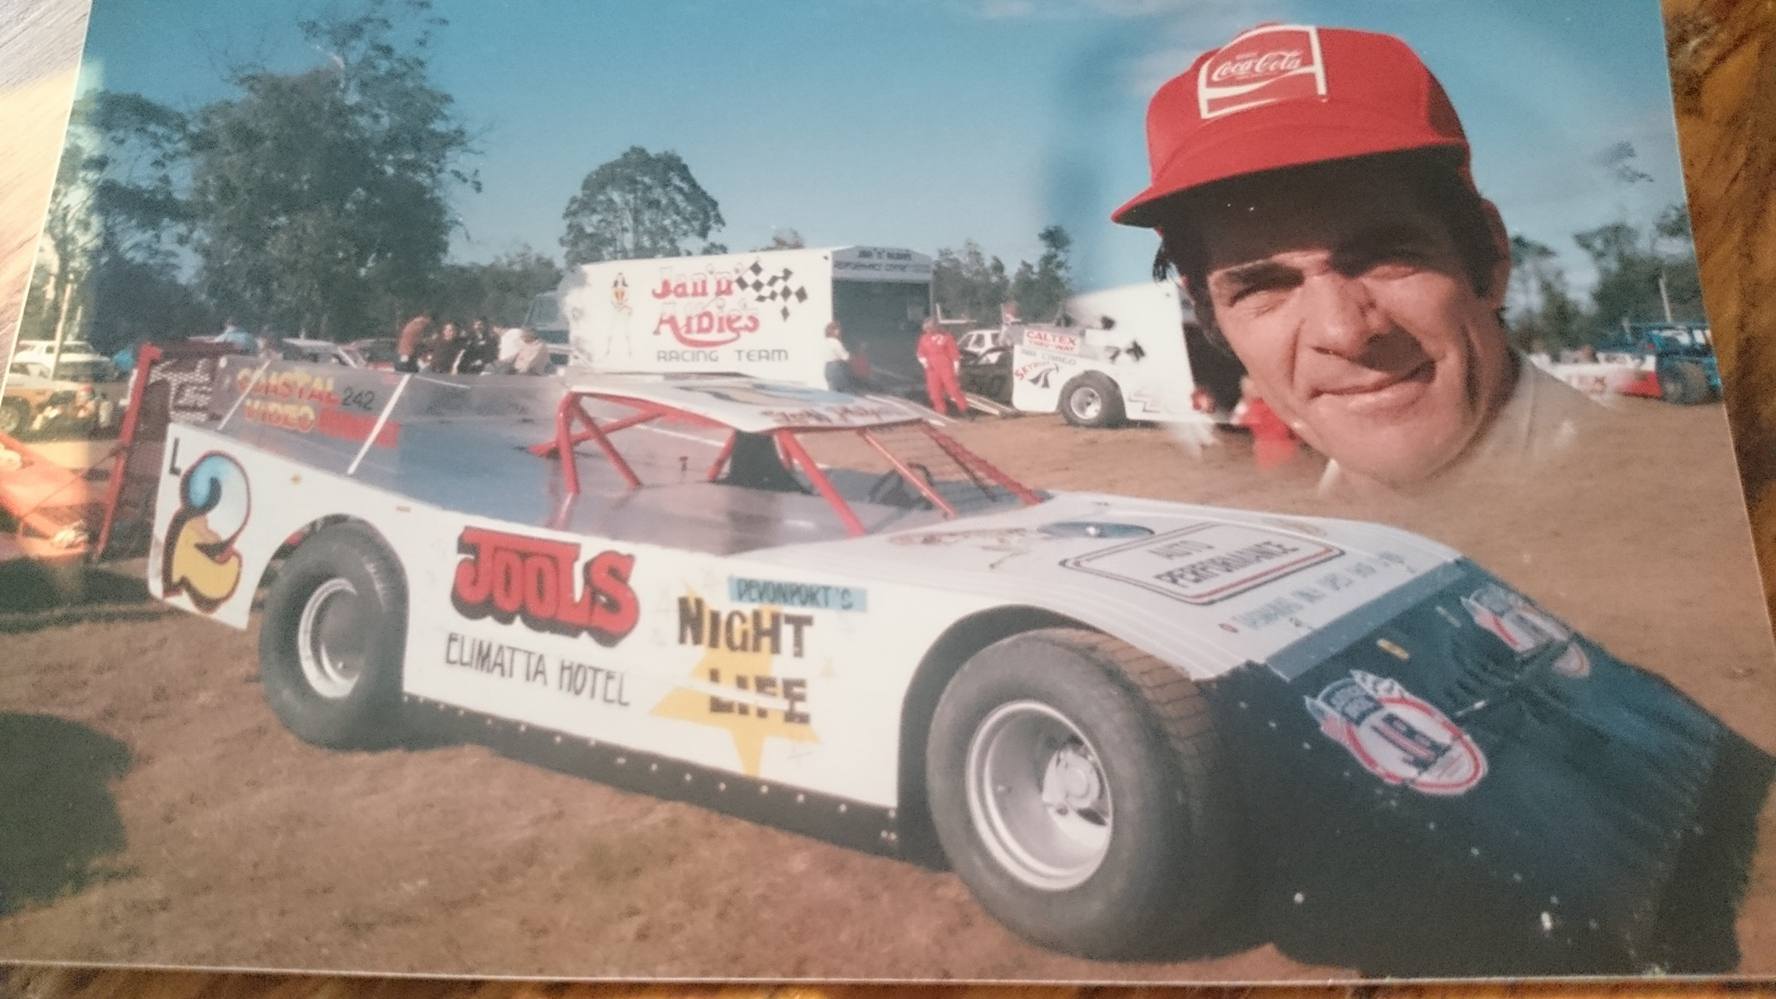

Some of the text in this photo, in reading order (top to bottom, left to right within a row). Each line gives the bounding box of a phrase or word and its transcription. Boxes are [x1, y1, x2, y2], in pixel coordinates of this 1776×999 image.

[1211, 50, 1303, 82] Coca-Cola
[656, 348, 789, 363] RACING TEAM
[1026, 330, 1077, 347] CALTEX
[341, 388, 376, 411] 242
[169, 437, 182, 476] L
[161, 450, 252, 614] 2
[451, 526, 641, 648] JOOLS
[677, 596, 814, 659] NIGHT
[558, 658, 631, 707] HOTEL
[709, 668, 811, 725] LIFE
